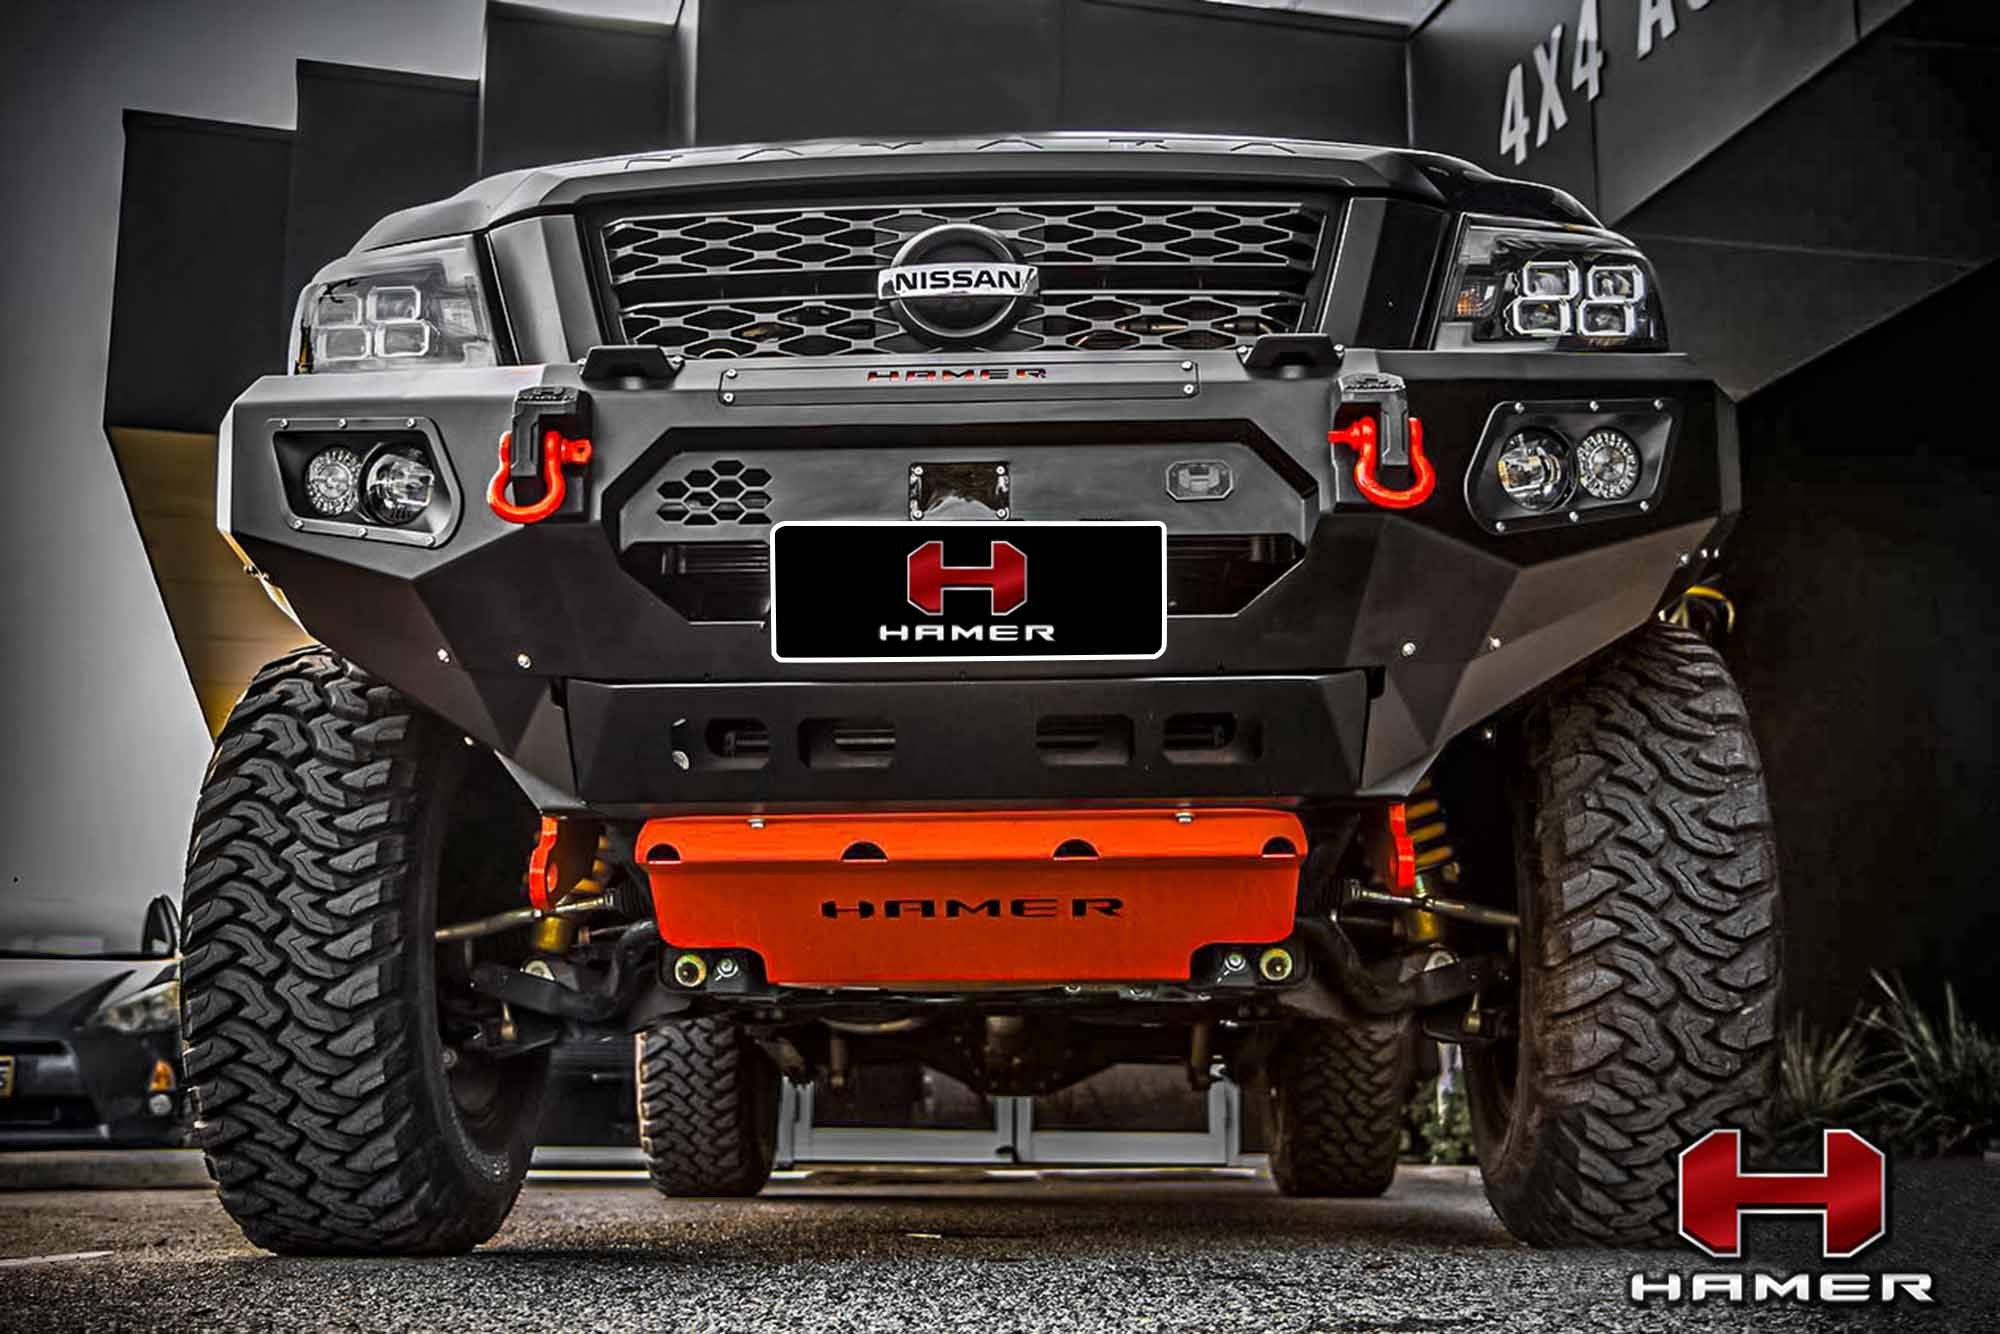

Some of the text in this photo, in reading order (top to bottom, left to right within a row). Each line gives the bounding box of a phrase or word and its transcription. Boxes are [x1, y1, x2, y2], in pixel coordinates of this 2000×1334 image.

[1500, 0, 1712, 165] 4X4 A
[895, 270, 1021, 292] NISSAN
[867, 368, 1047, 382] HAMER
[879, 624, 1055, 642] HAMER
[821, 899, 1123, 919] HAMER
